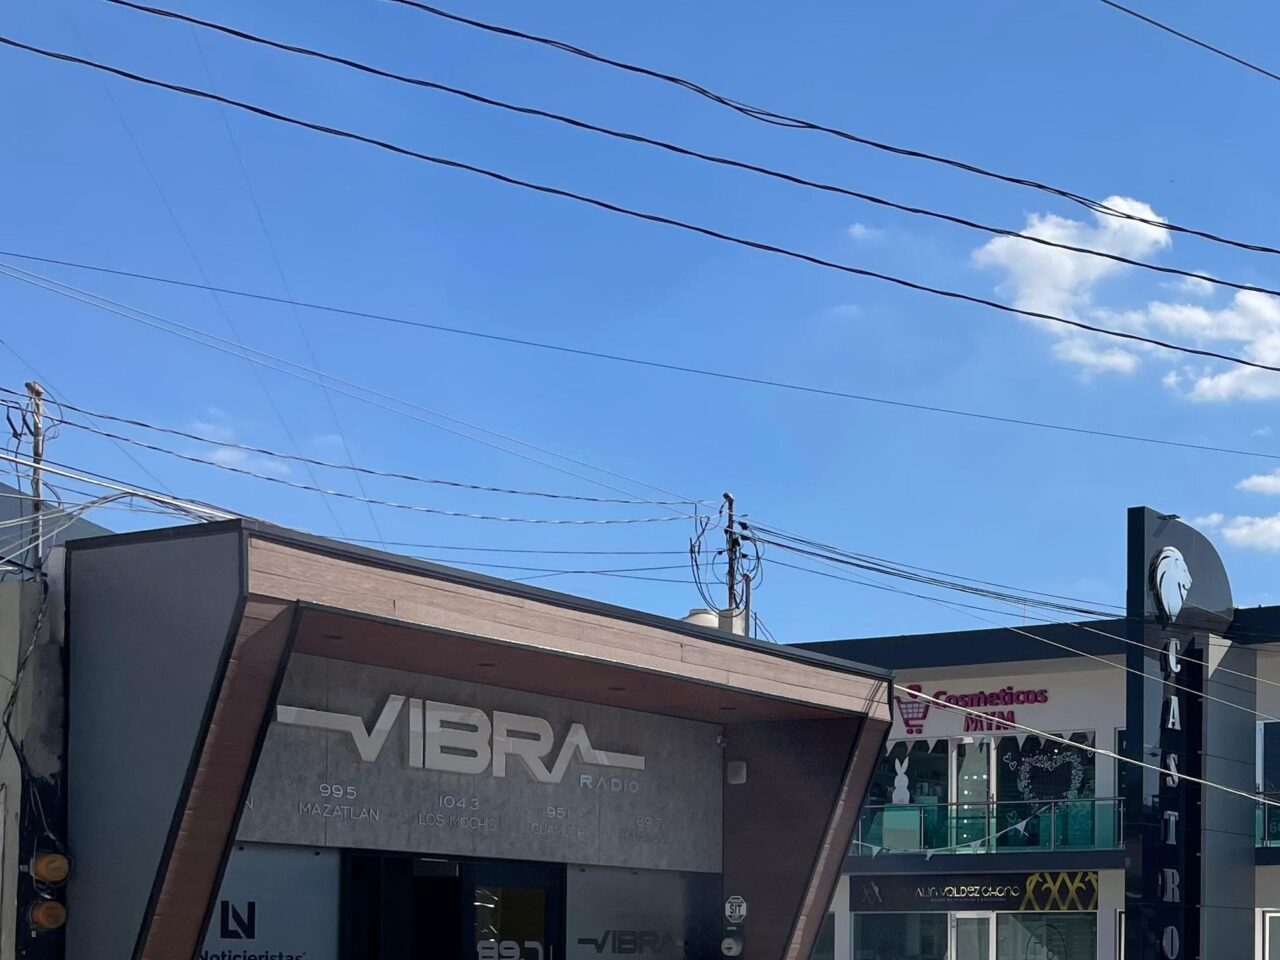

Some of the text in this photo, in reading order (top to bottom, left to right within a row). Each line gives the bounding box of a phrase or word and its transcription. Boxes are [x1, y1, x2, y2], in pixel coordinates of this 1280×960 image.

[277, 694, 645, 784] VIBRA
[580, 774, 640, 793] RADIO
[1162, 638, 1181, 960] CASTRO
[299, 803, 380, 821] MAZATLAN
[418, 813, 445, 826] LOS
